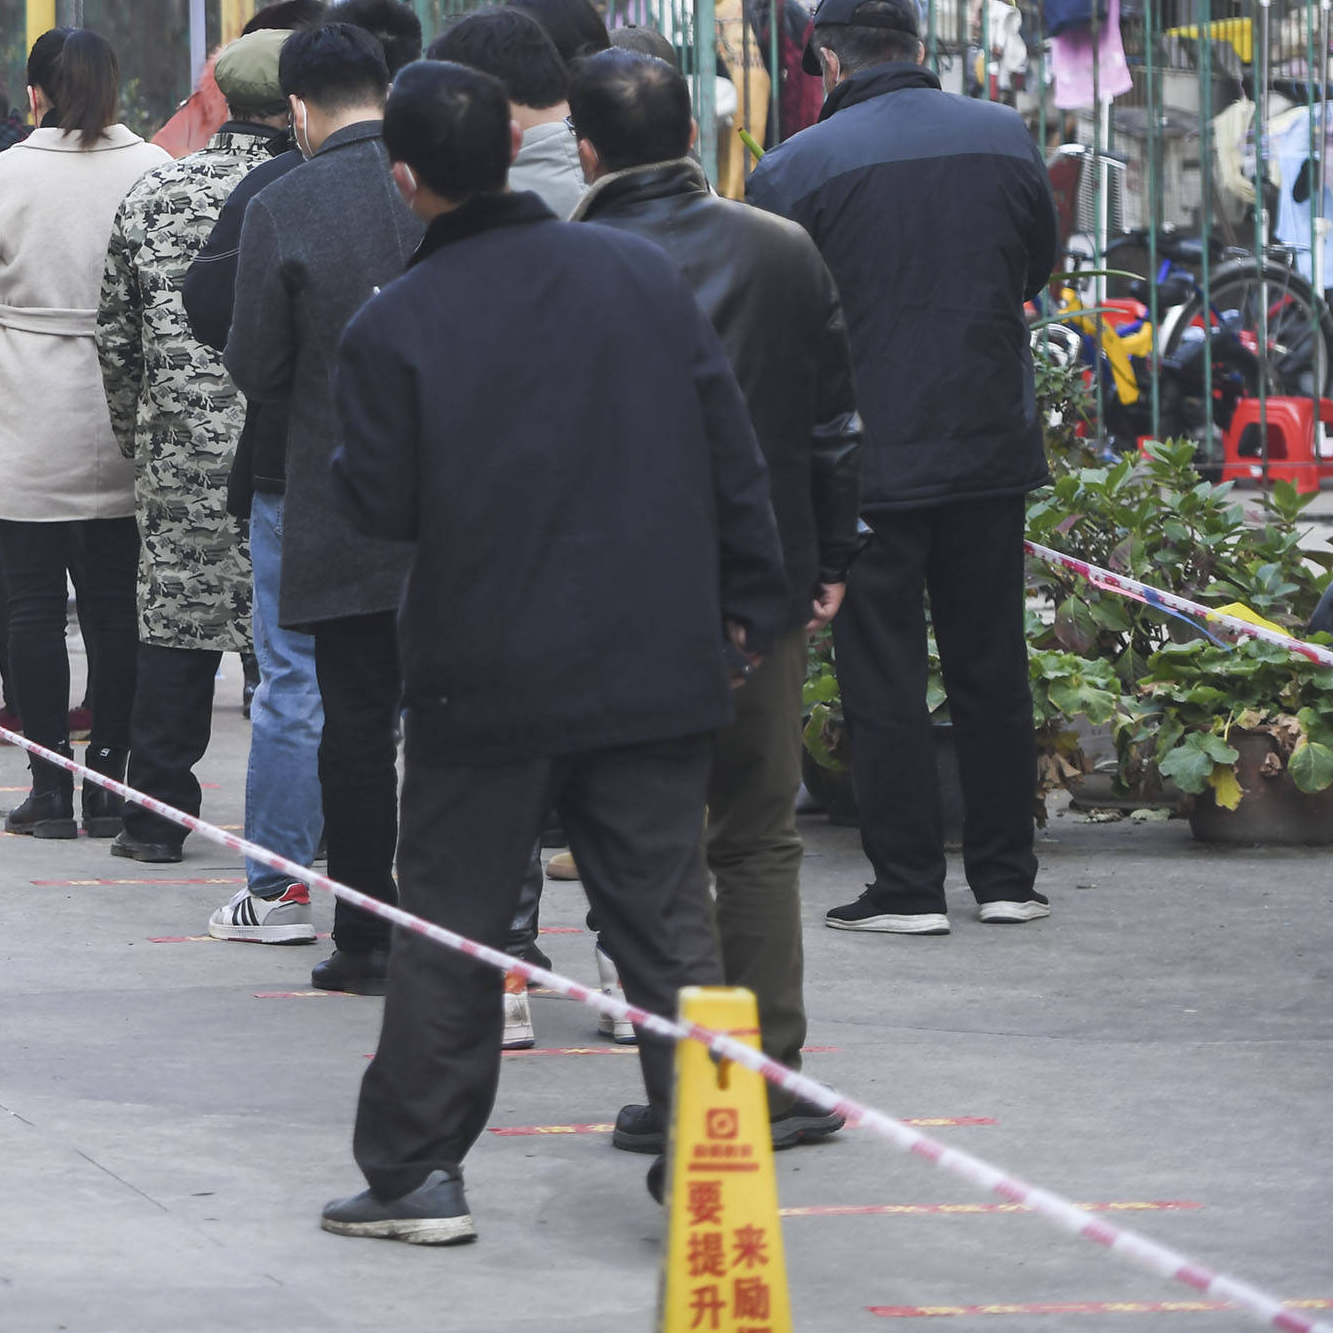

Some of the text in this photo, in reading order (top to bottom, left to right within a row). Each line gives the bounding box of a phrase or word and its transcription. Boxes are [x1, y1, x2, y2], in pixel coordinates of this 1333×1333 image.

[687, 1180, 727, 1330] 要提升
[733, 1224, 772, 1333] 来励
